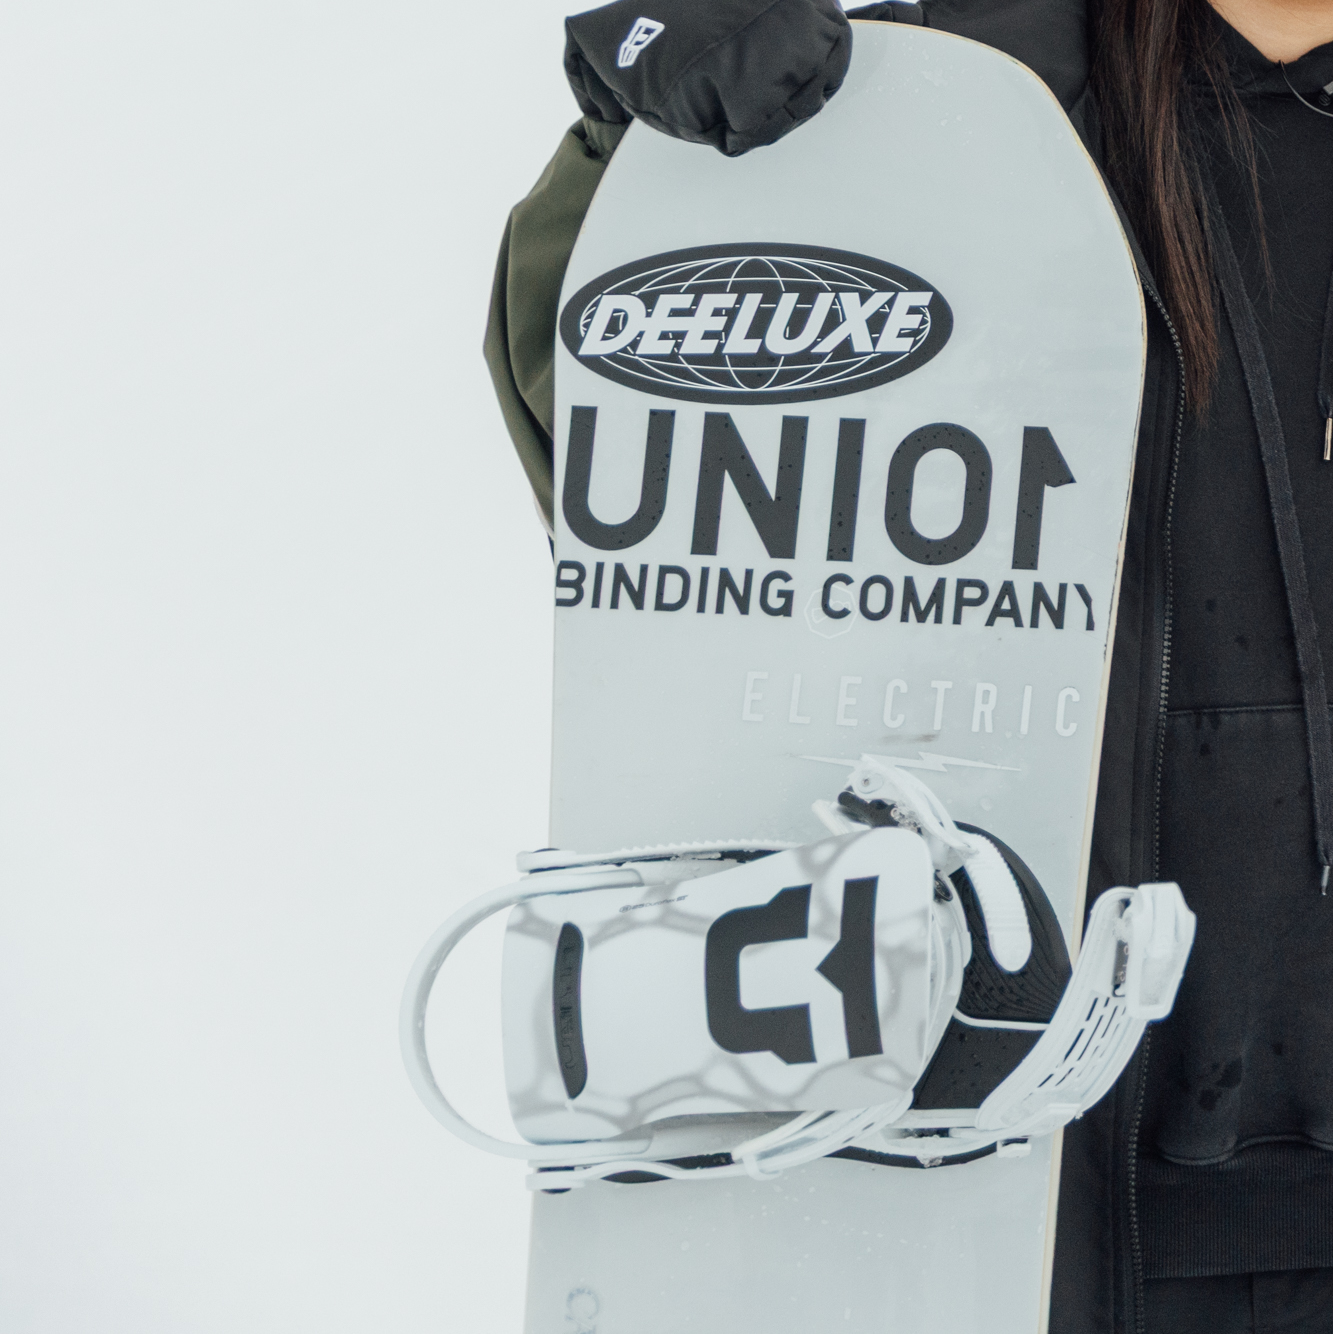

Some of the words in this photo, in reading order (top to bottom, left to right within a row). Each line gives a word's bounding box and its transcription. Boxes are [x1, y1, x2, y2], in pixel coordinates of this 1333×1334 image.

[577, 290, 933, 357] DEELUXE
[554, 559, 795, 618] BINDING
[741, 671, 1081, 738] ELECTRIC
